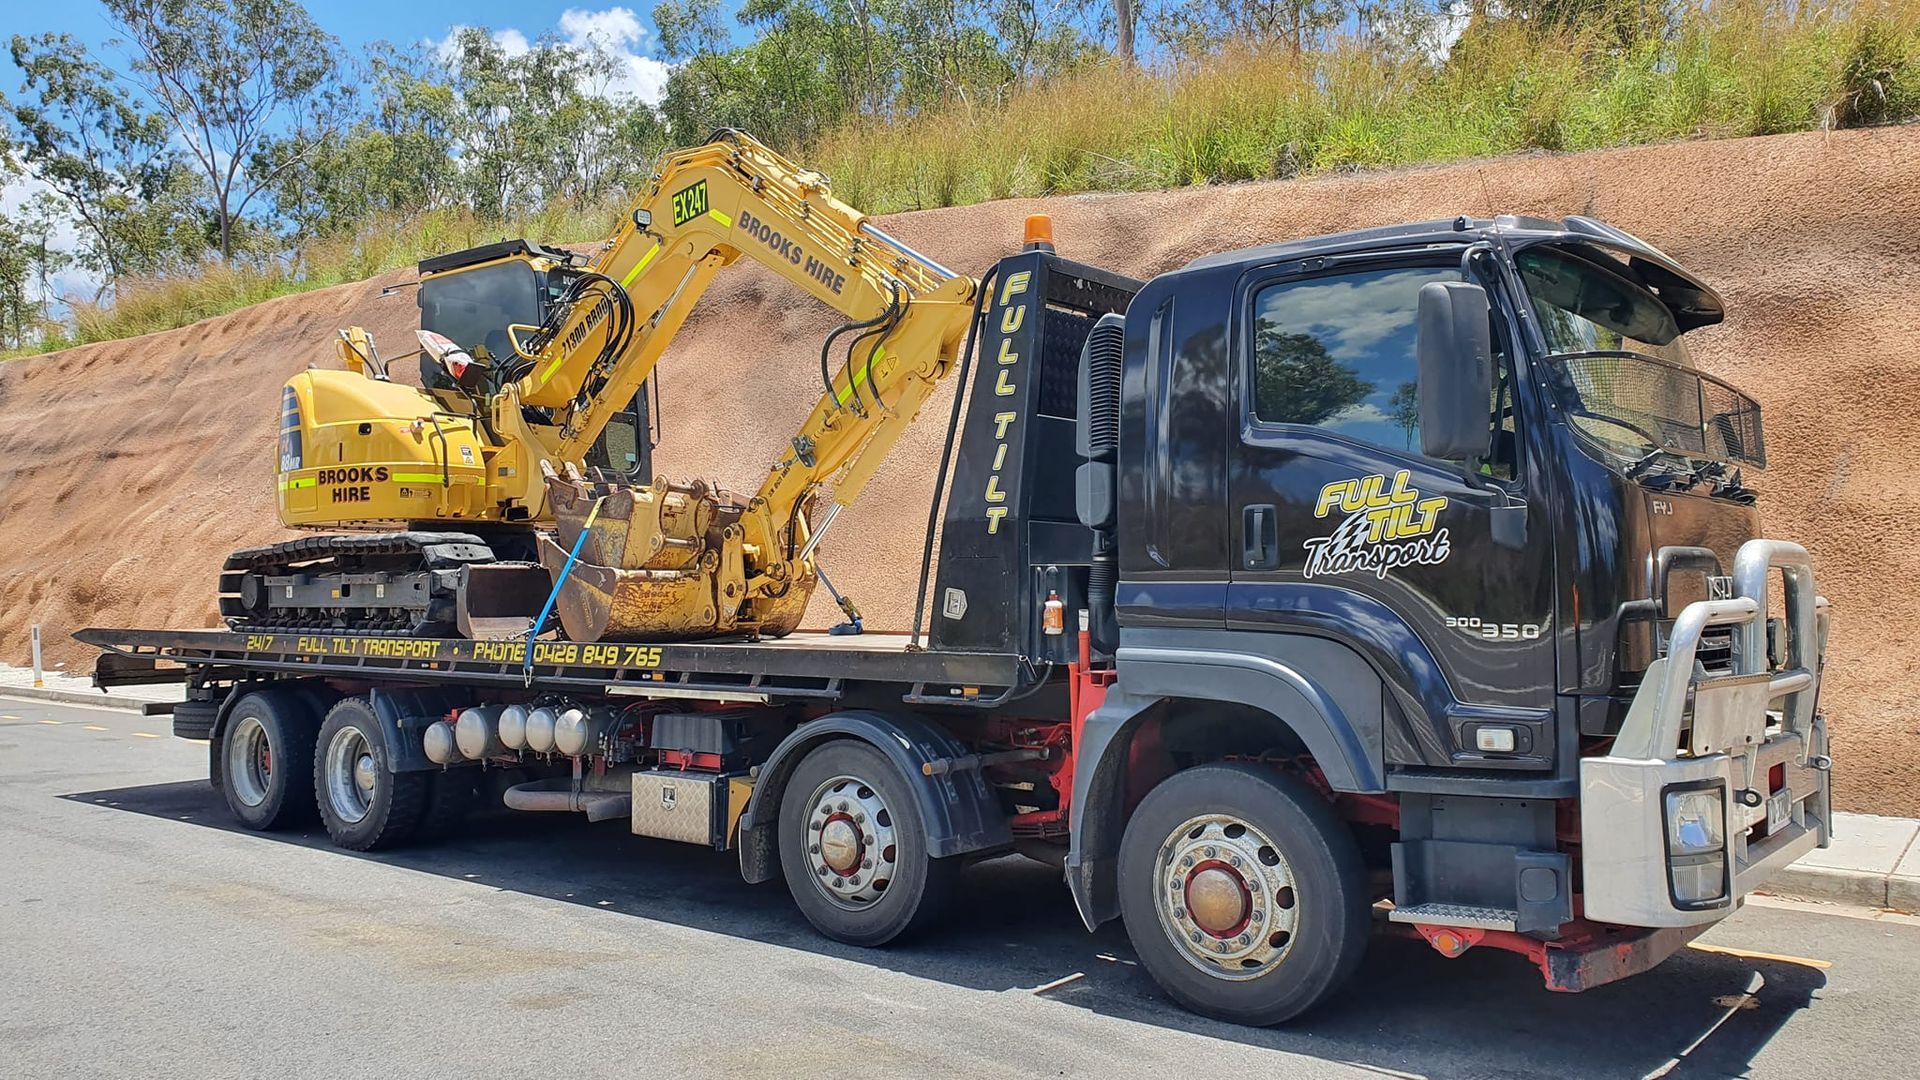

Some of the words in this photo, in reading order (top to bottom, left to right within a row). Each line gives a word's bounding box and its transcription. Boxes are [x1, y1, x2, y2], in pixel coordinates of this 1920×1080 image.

[673, 181, 708, 225] EX247
[738, 210, 803, 265] BROOKS
[803, 255, 846, 295] HIRE
[995, 270, 1032, 397] FULL
[318, 466, 389, 485] BROOKS
[332, 486, 371, 503] HIRE
[985, 411, 1017, 535] TILT
[1314, 469, 1419, 519] FULL
[1365, 496, 1449, 543] TILT
[1303, 528, 1451, 580] Transport
[246, 635, 273, 651] 24/7
[297, 636, 328, 653] FULL
[332, 637, 359, 654] TILT
[363, 638, 441, 658] TRANSPORT
[473, 642, 525, 662] PHONE
[532, 644, 577, 664] 0428
[582, 645, 619, 665] 849
[622, 646, 663, 667] 765
[1445, 616, 1481, 628] 300
[1482, 622, 1540, 639] 350
